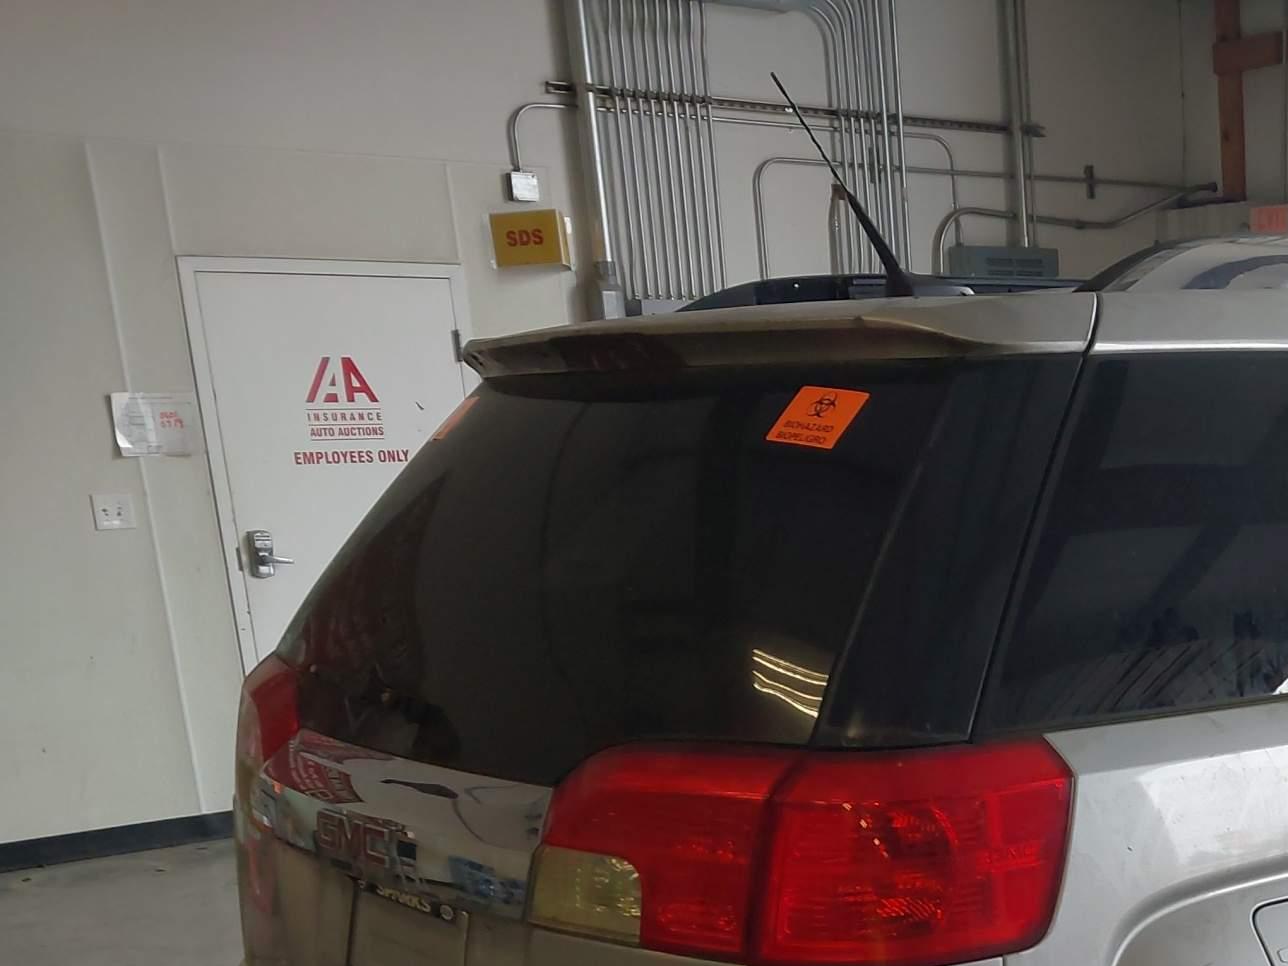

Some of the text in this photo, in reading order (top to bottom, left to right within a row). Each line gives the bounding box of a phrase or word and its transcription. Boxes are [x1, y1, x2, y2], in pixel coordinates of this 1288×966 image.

[506, 228, 544, 247] SDS
[307, 412, 383, 422] INSURANCE
[310, 426, 384, 437] AUTO AUCTIONS
[294, 449, 409, 465] EMPLOYEES ONLY
[316, 808, 390, 868] GMC
